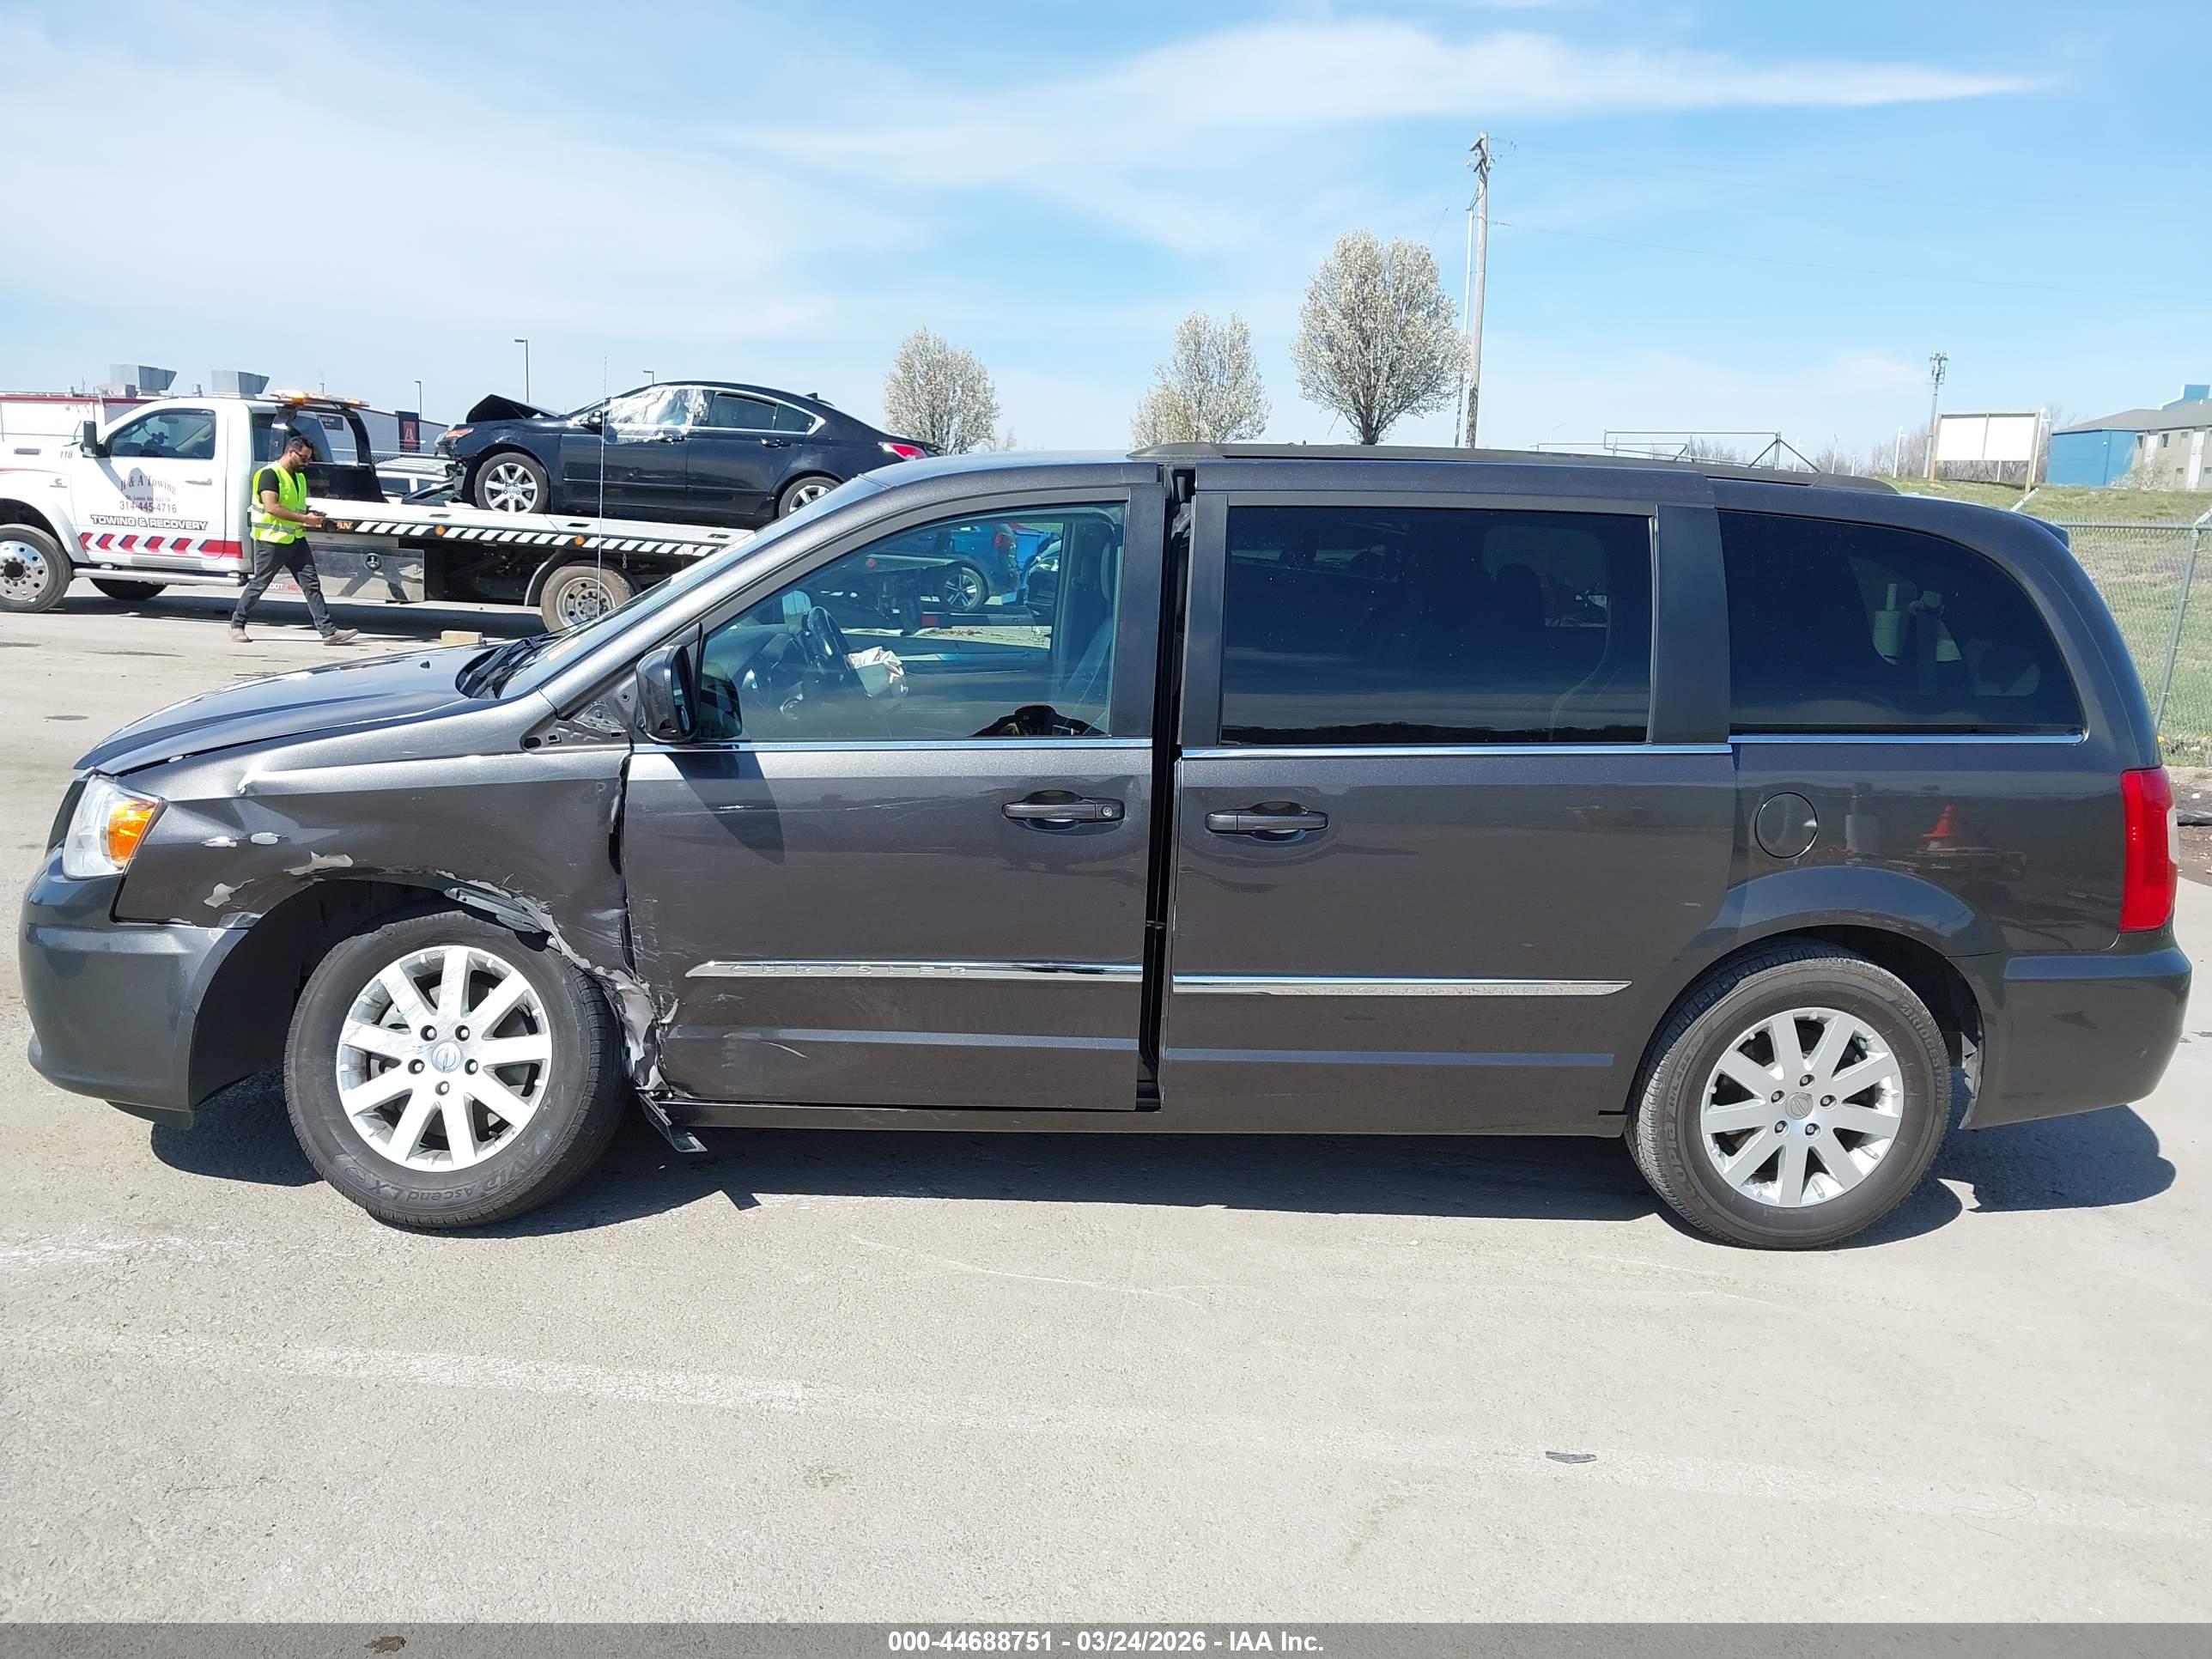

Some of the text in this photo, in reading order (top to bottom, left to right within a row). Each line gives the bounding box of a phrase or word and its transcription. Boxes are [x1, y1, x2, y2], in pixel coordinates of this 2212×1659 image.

[129, 476, 135, 488] &
[137, 475, 144, 487] A
[119, 500, 177, 514] 314-445-4716
[91, 515, 208, 531] TOWING & RECOVERY
[405, 1184, 477, 1202] Ascend
